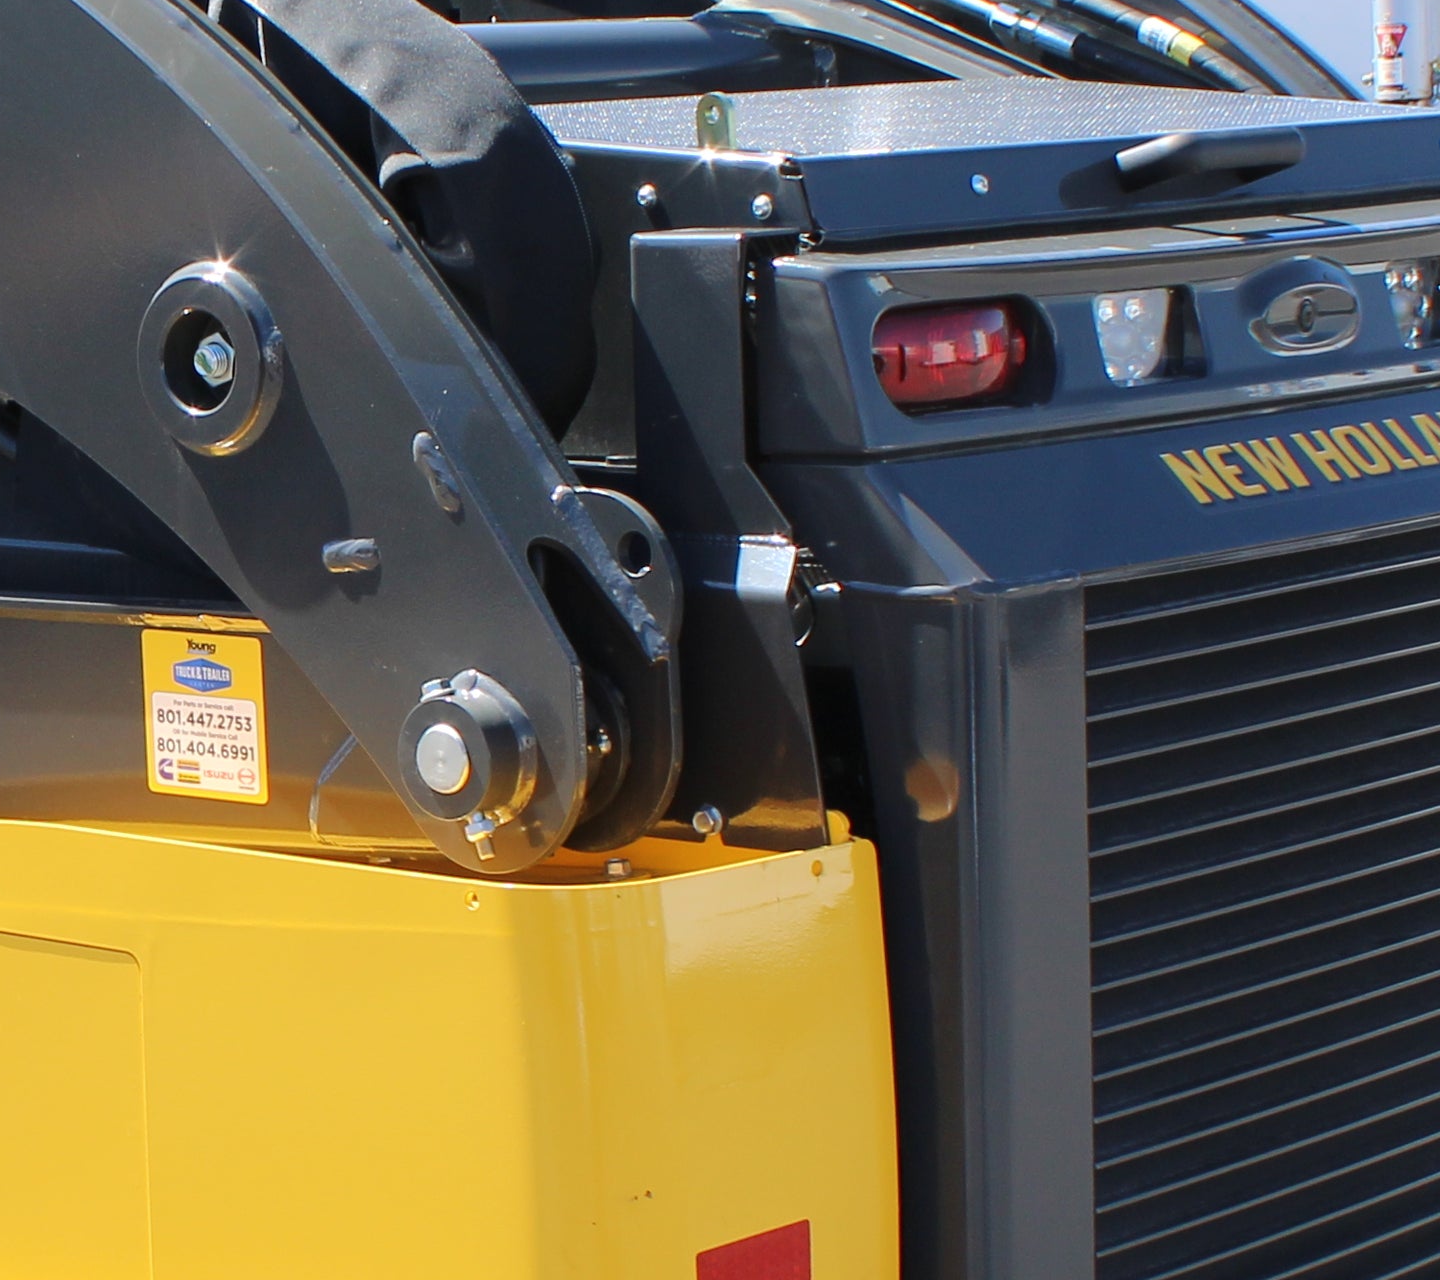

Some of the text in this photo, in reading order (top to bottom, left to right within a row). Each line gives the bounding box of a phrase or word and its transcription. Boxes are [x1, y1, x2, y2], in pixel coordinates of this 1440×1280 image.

[1159, 435, 1310, 505] NEW
[186, 639, 216, 655] Young
[157, 708, 252, 732] 801.447.2753
[157, 737, 255, 762] 801.404.6991
[203, 769, 234, 781] ISUZU
